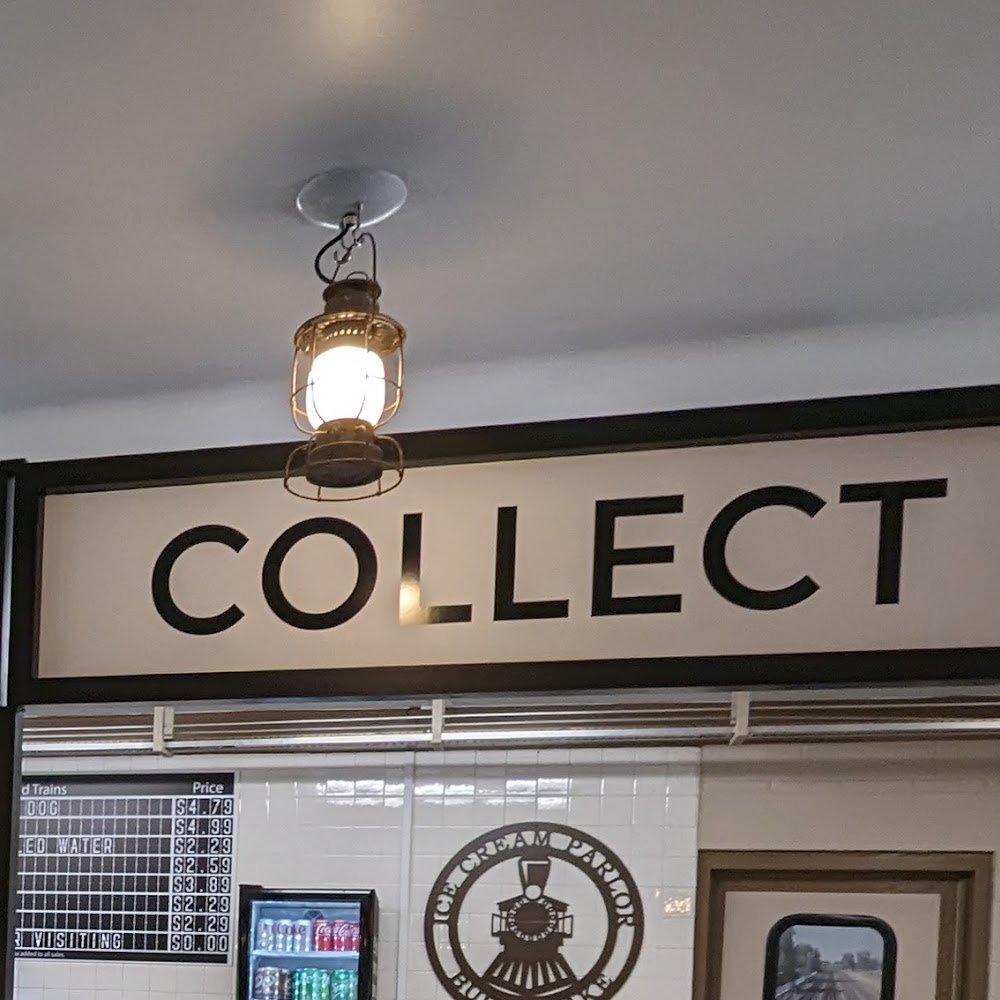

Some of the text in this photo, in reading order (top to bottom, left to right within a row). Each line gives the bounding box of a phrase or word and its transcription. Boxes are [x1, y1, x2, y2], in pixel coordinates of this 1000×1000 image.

[151, 478, 948, 636] COLLECT
[33, 784, 67, 795] Trains
[193, 782, 224, 794] Price
[27, 801, 58, 816] DOG
[58, 838, 113, 853] WATER
[433, 831, 635, 928] ICE CREAM PARLOR
[34, 932, 121, 949] VISITING
